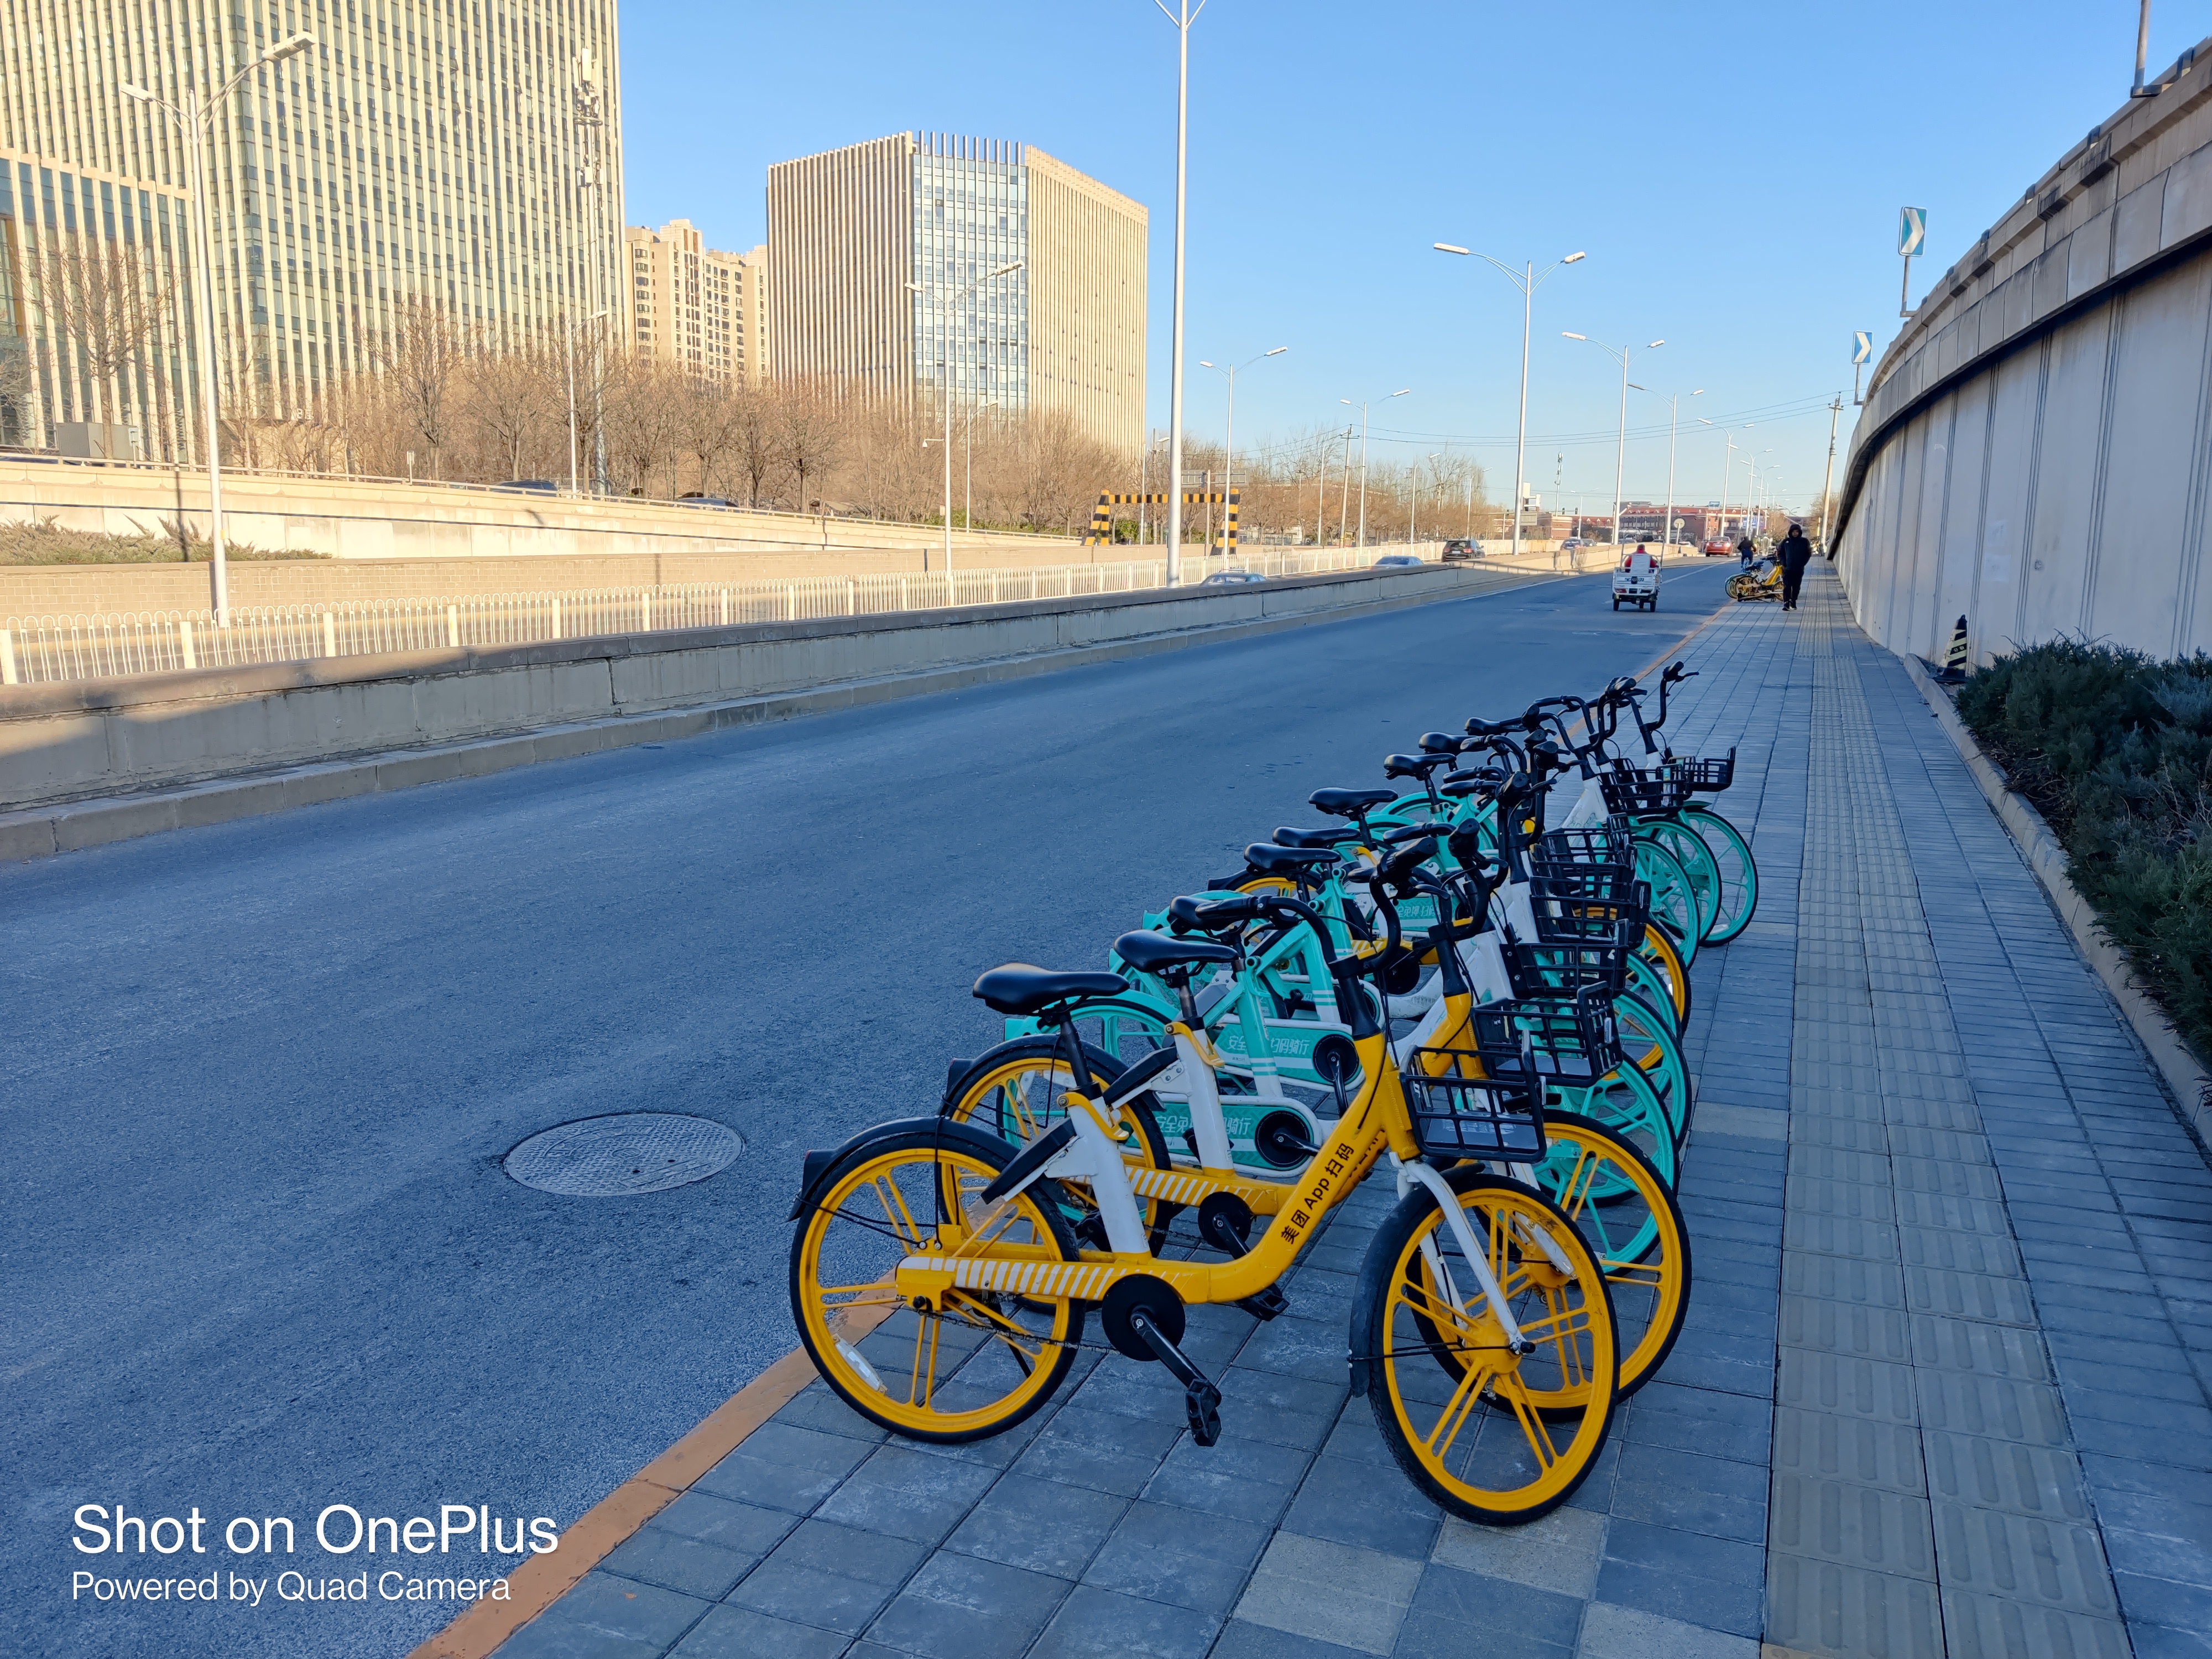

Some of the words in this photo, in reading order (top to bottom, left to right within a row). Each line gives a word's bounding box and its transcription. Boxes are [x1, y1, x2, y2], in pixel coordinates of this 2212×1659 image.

[1281, 1209, 1311, 1244] 美团
[1304, 1178, 1330, 1211] App
[1324, 1142, 1354, 1178] 扫码
